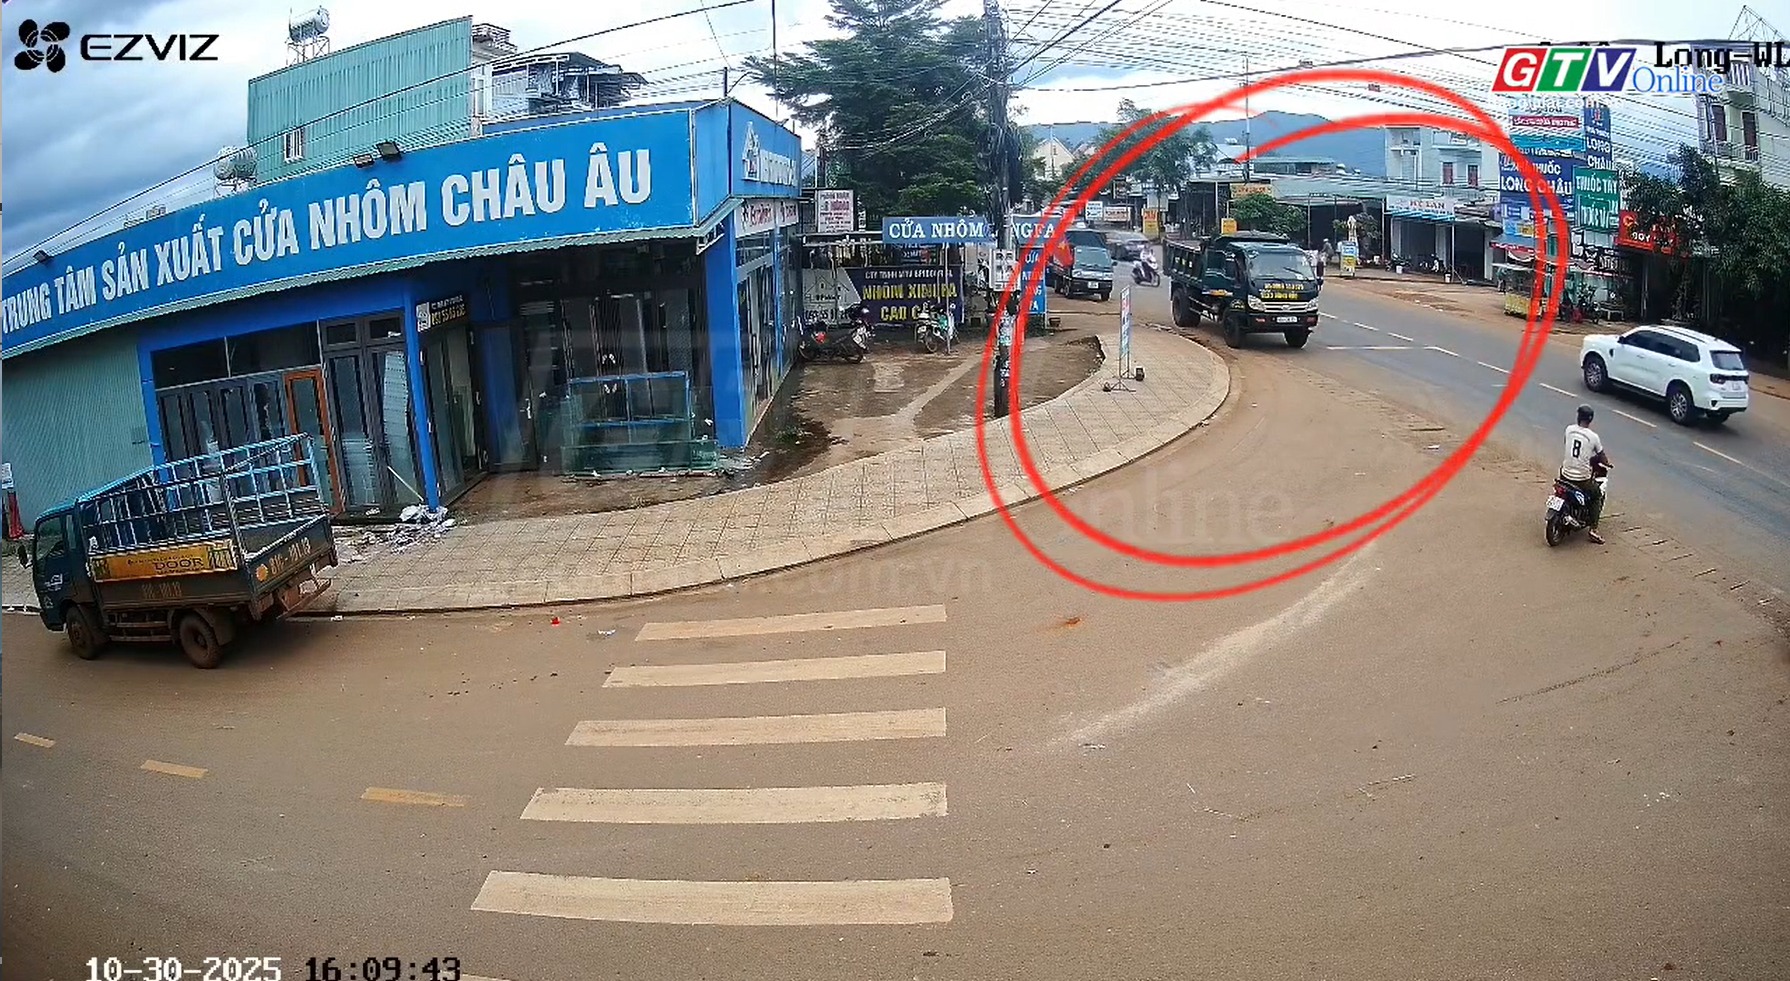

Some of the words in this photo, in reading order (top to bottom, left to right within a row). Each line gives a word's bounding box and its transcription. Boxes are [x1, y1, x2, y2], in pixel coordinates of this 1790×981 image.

[2, 282, 52, 334] TRUNG
[54, 264, 98, 315] TÂM
[101, 241, 150, 301] SẢN
[154, 213, 224, 286] XUẤT
[233, 198, 300, 266] CỬA
[308, 178, 428, 250] NHÔM
[440, 152, 567, 227] CHÂU
[584, 141, 652, 208] ÂU
[888, 217, 927, 239] CỬA
[931, 217, 985, 239] NHÔM
